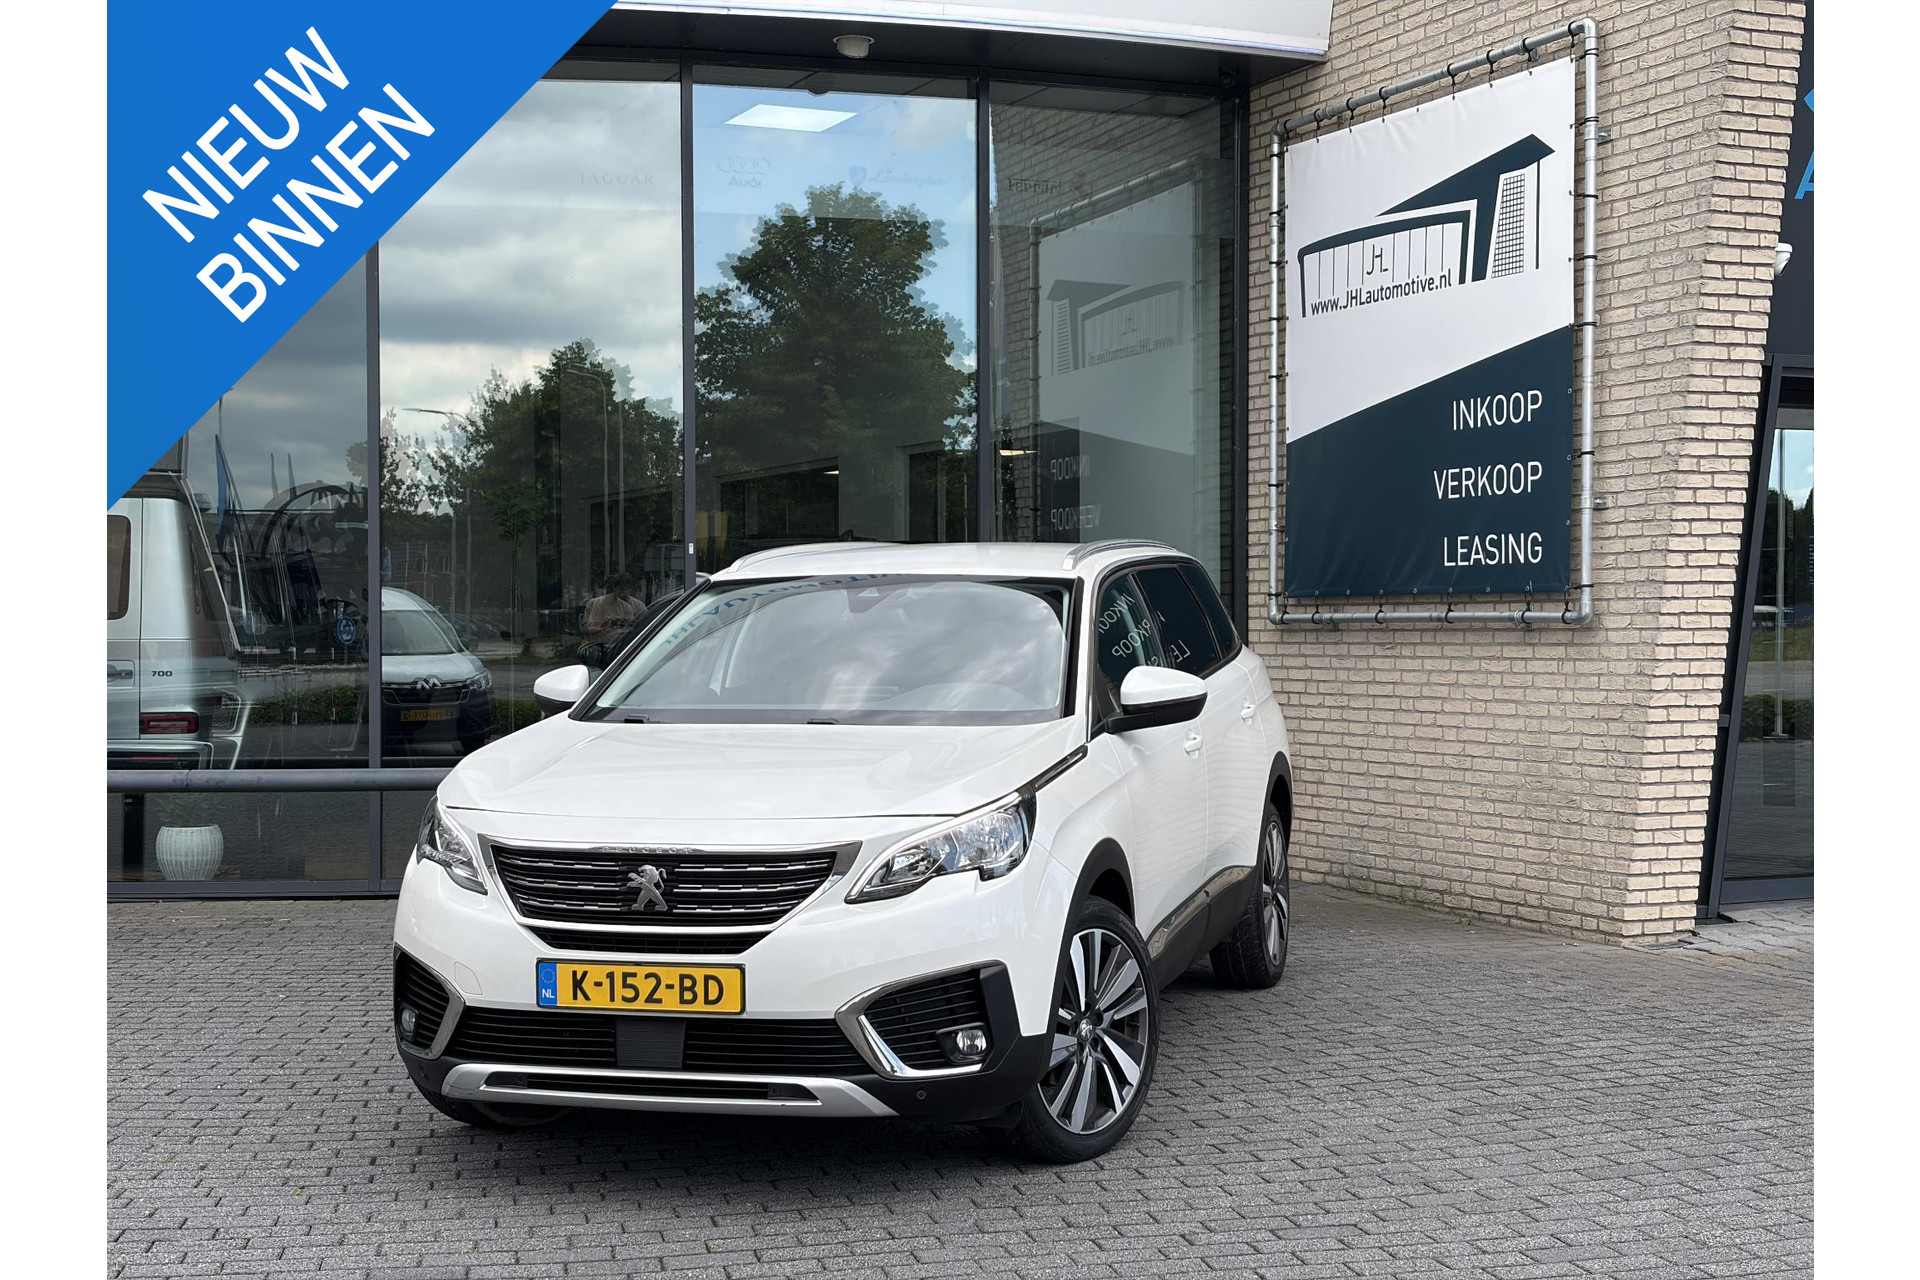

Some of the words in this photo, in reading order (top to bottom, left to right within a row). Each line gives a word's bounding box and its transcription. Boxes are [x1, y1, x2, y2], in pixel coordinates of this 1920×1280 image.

[1366, 244, 1388, 275] JHL
[1311, 268, 1452, 315] www.JHLautomotive.nl
[1453, 390, 1542, 431] INKOOP
[1433, 461, 1543, 500] VERKOOP
[1443, 532, 1543, 567] LEASING
[541, 988, 556, 999] NL
[571, 970, 724, 1006] K-152-BD
